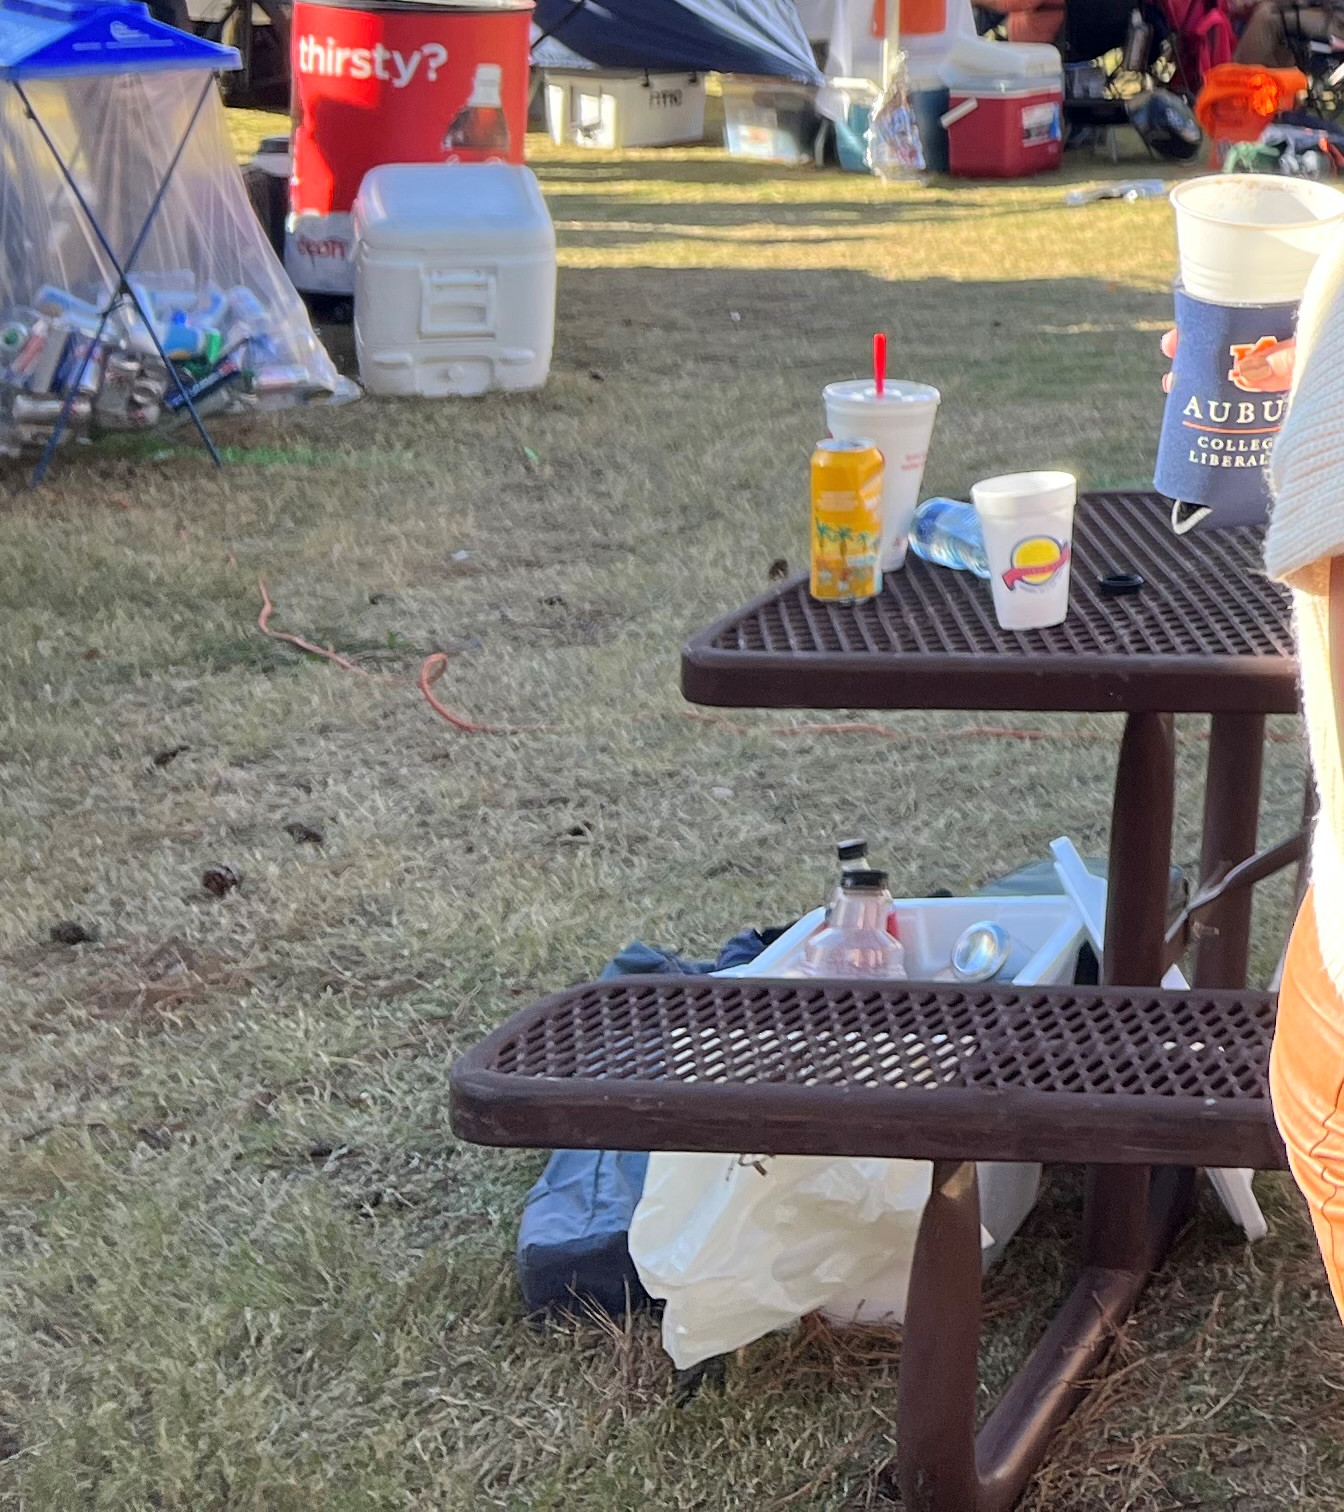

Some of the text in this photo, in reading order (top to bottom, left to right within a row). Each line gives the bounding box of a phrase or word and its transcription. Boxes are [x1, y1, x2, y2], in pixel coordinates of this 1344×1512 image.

[298, 34, 448, 88] thirsty?
[1182, 395, 1284, 424] AUBU
[1197, 436, 1274, 452] COLLEG
